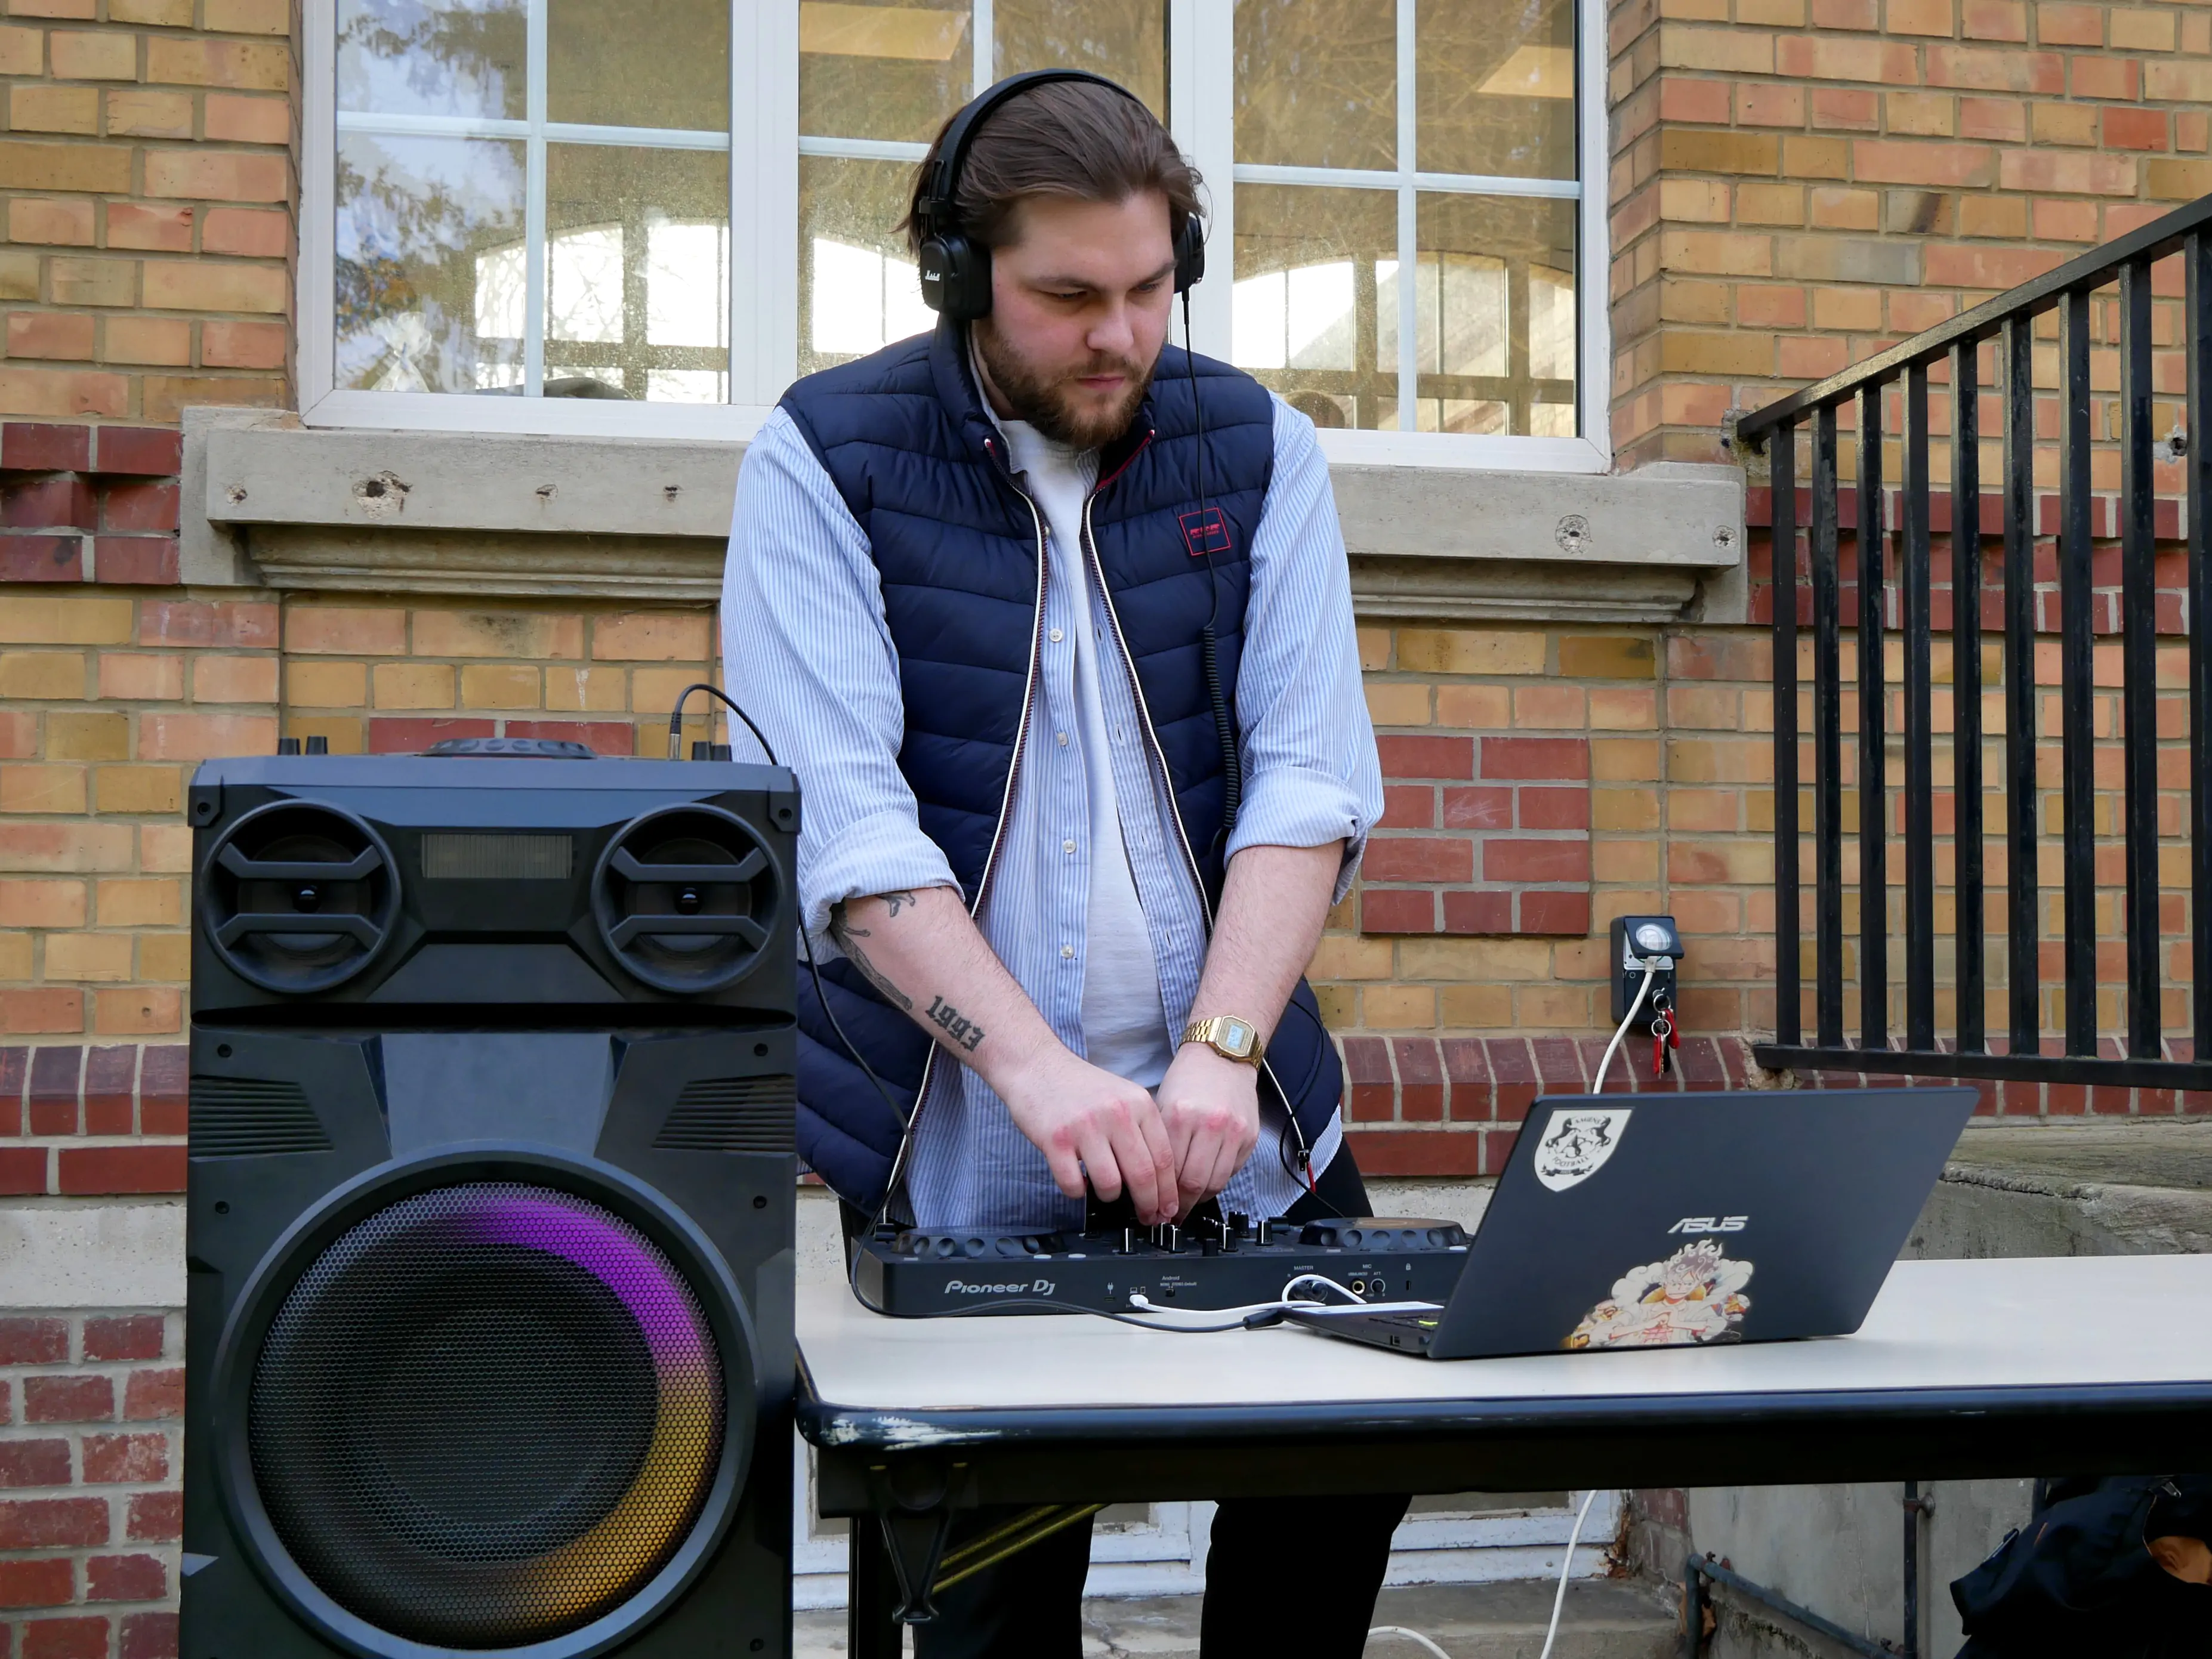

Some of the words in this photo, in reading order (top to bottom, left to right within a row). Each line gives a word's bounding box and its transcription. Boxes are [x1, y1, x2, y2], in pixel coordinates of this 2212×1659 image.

[925, 995, 985, 1052] 1993
[1667, 1216, 1748, 1233] ASUS
[945, 1280, 1028, 1293] Pioneer
